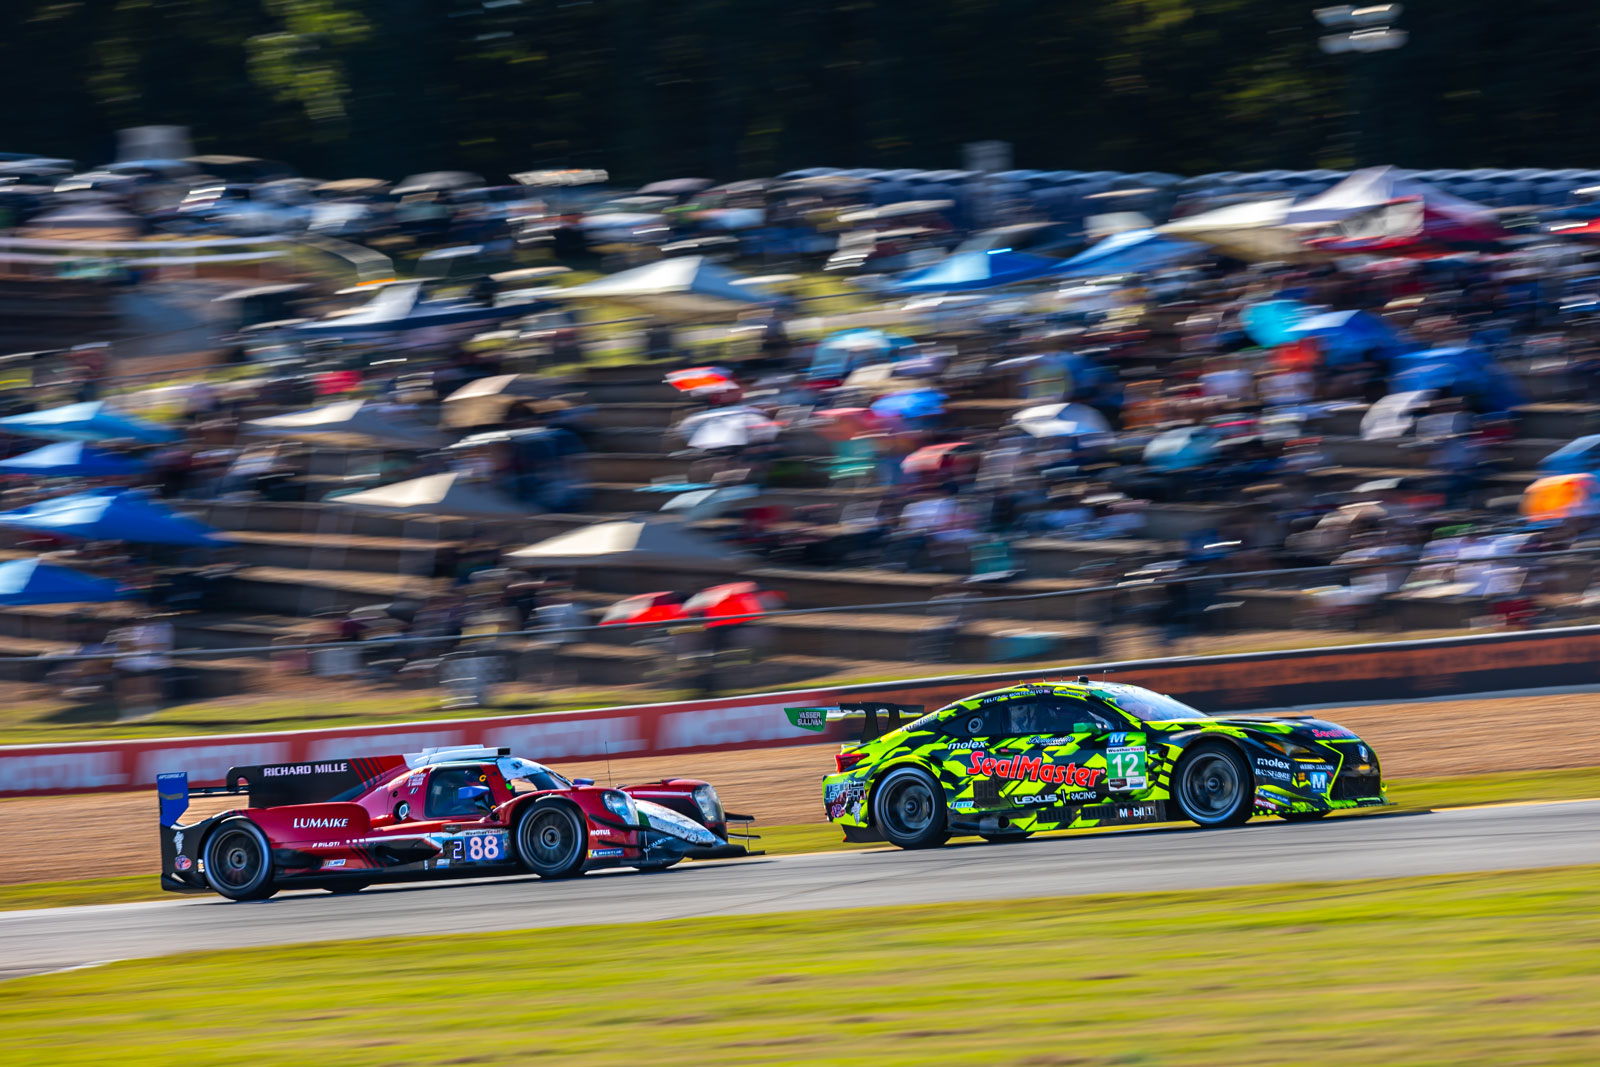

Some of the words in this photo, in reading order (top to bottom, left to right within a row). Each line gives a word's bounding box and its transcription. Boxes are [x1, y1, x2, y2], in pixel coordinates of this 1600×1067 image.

[1009, 689, 1043, 698] MONTECALVO
[799, 711, 821, 719] VASSER
[797, 718, 823, 726] SULLIVAN
[947, 739, 987, 750] molex
[263, 765, 312, 777] RICHARD
[314, 762, 348, 774] MILLE
[966, 750, 1102, 788] SealMaster
[1112, 753, 1139, 777] 12
[1257, 757, 1290, 770] molex
[1014, 794, 1058, 804] LEXUS
[1070, 791, 1097, 800] RACING
[1119, 806, 1145, 818] Mobil
[293, 817, 349, 829] LUMAIKE
[453, 841, 462, 859] 2
[469, 835, 499, 860] 88
